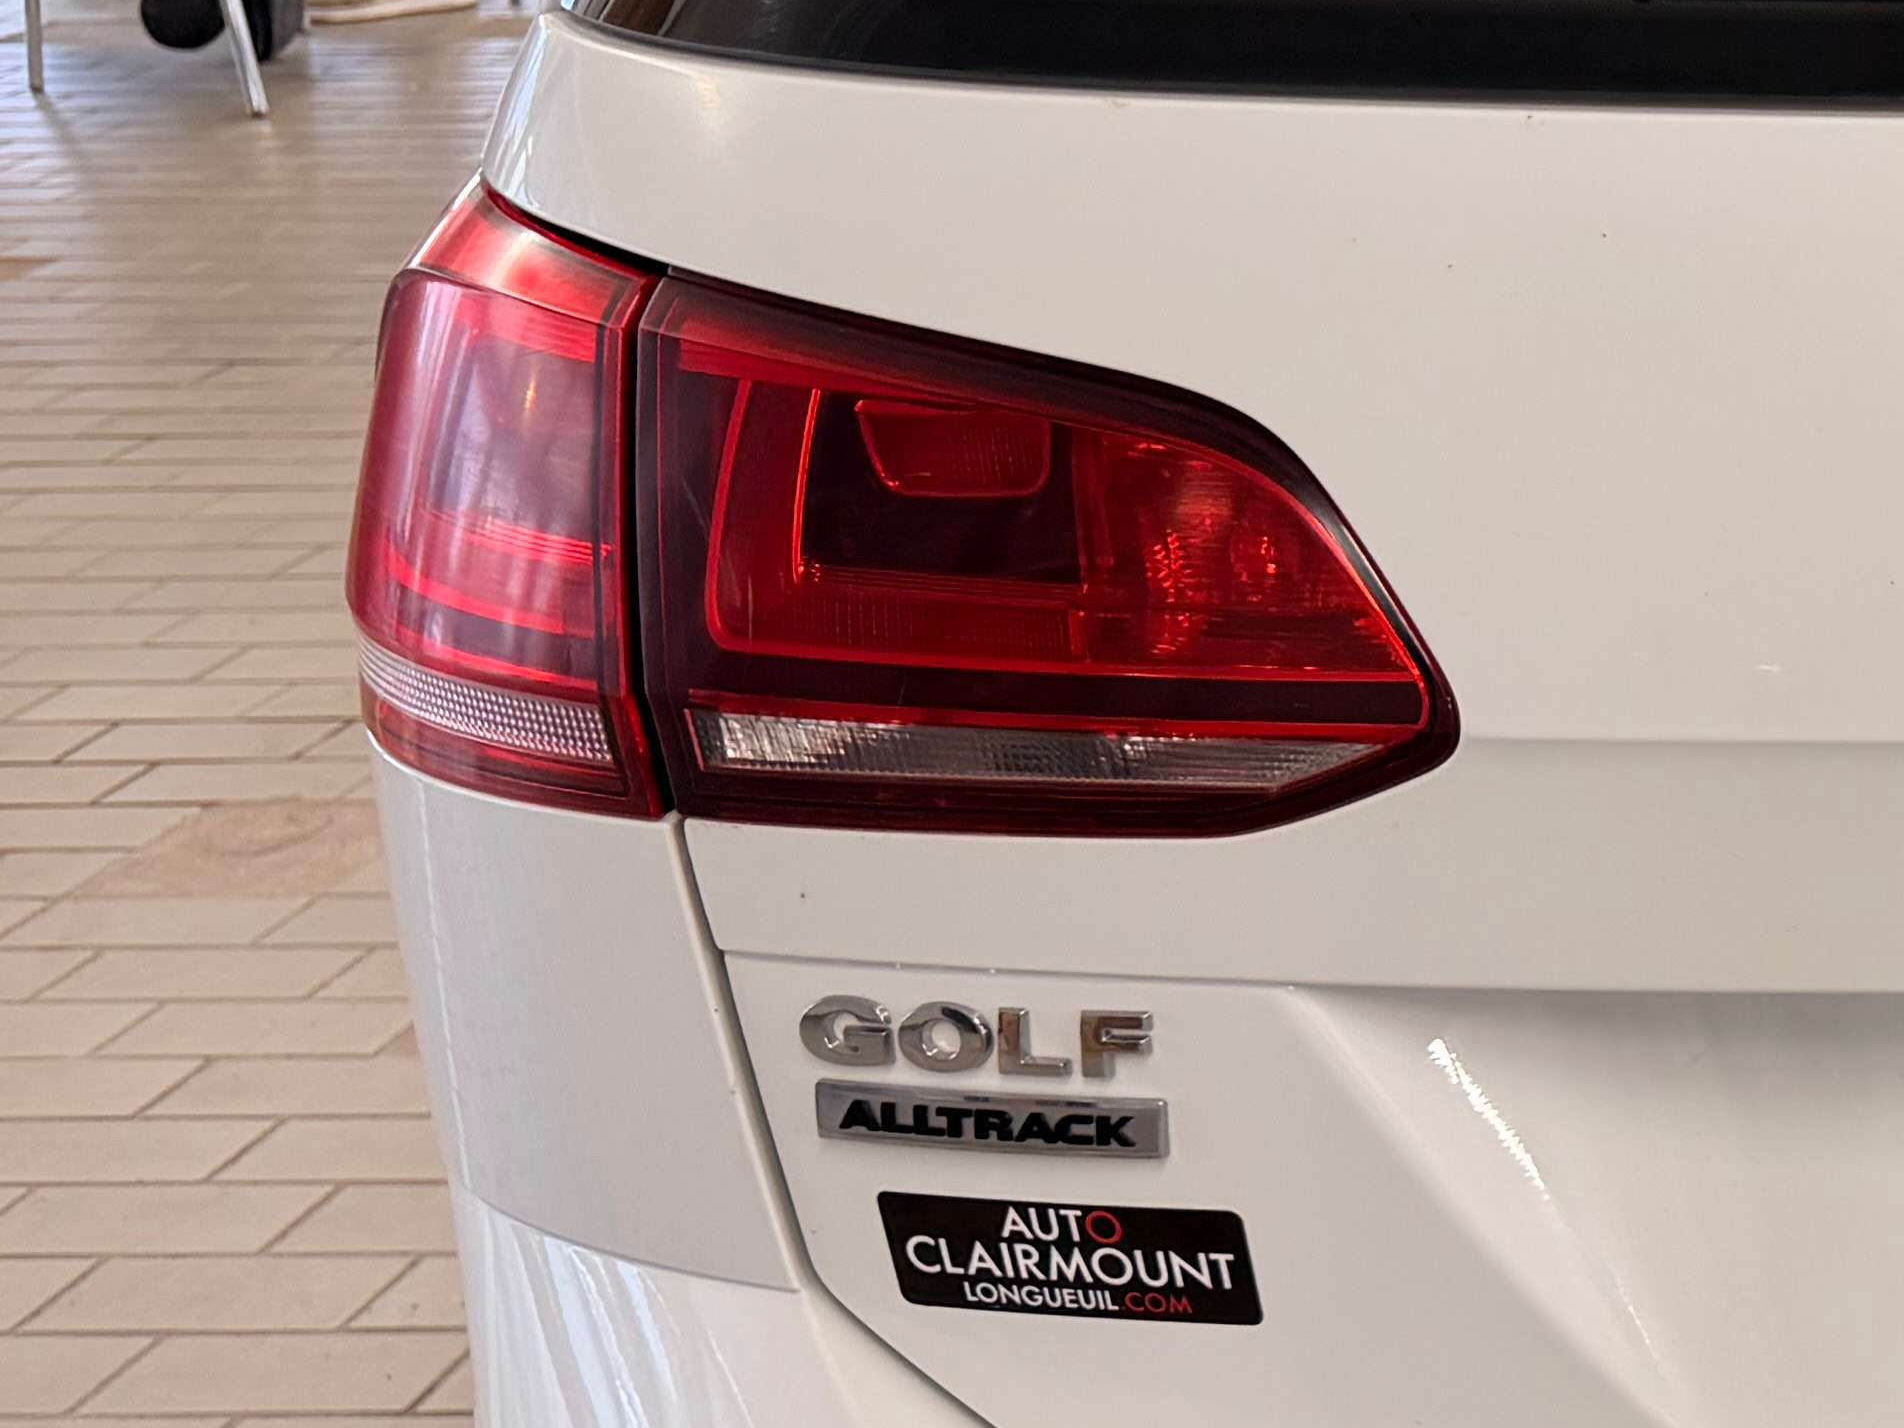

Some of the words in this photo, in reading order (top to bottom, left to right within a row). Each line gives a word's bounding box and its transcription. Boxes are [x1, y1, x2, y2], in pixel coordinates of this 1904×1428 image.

[799, 994, 1153, 1079] GOLF
[840, 1099, 1136, 1148] ALLTRACK
[1001, 1206, 1122, 1245] AUTO
[905, 1234, 1235, 1291] CLAIRMOUNT
[965, 1280, 1193, 1315] LONGUEUIL.COM
